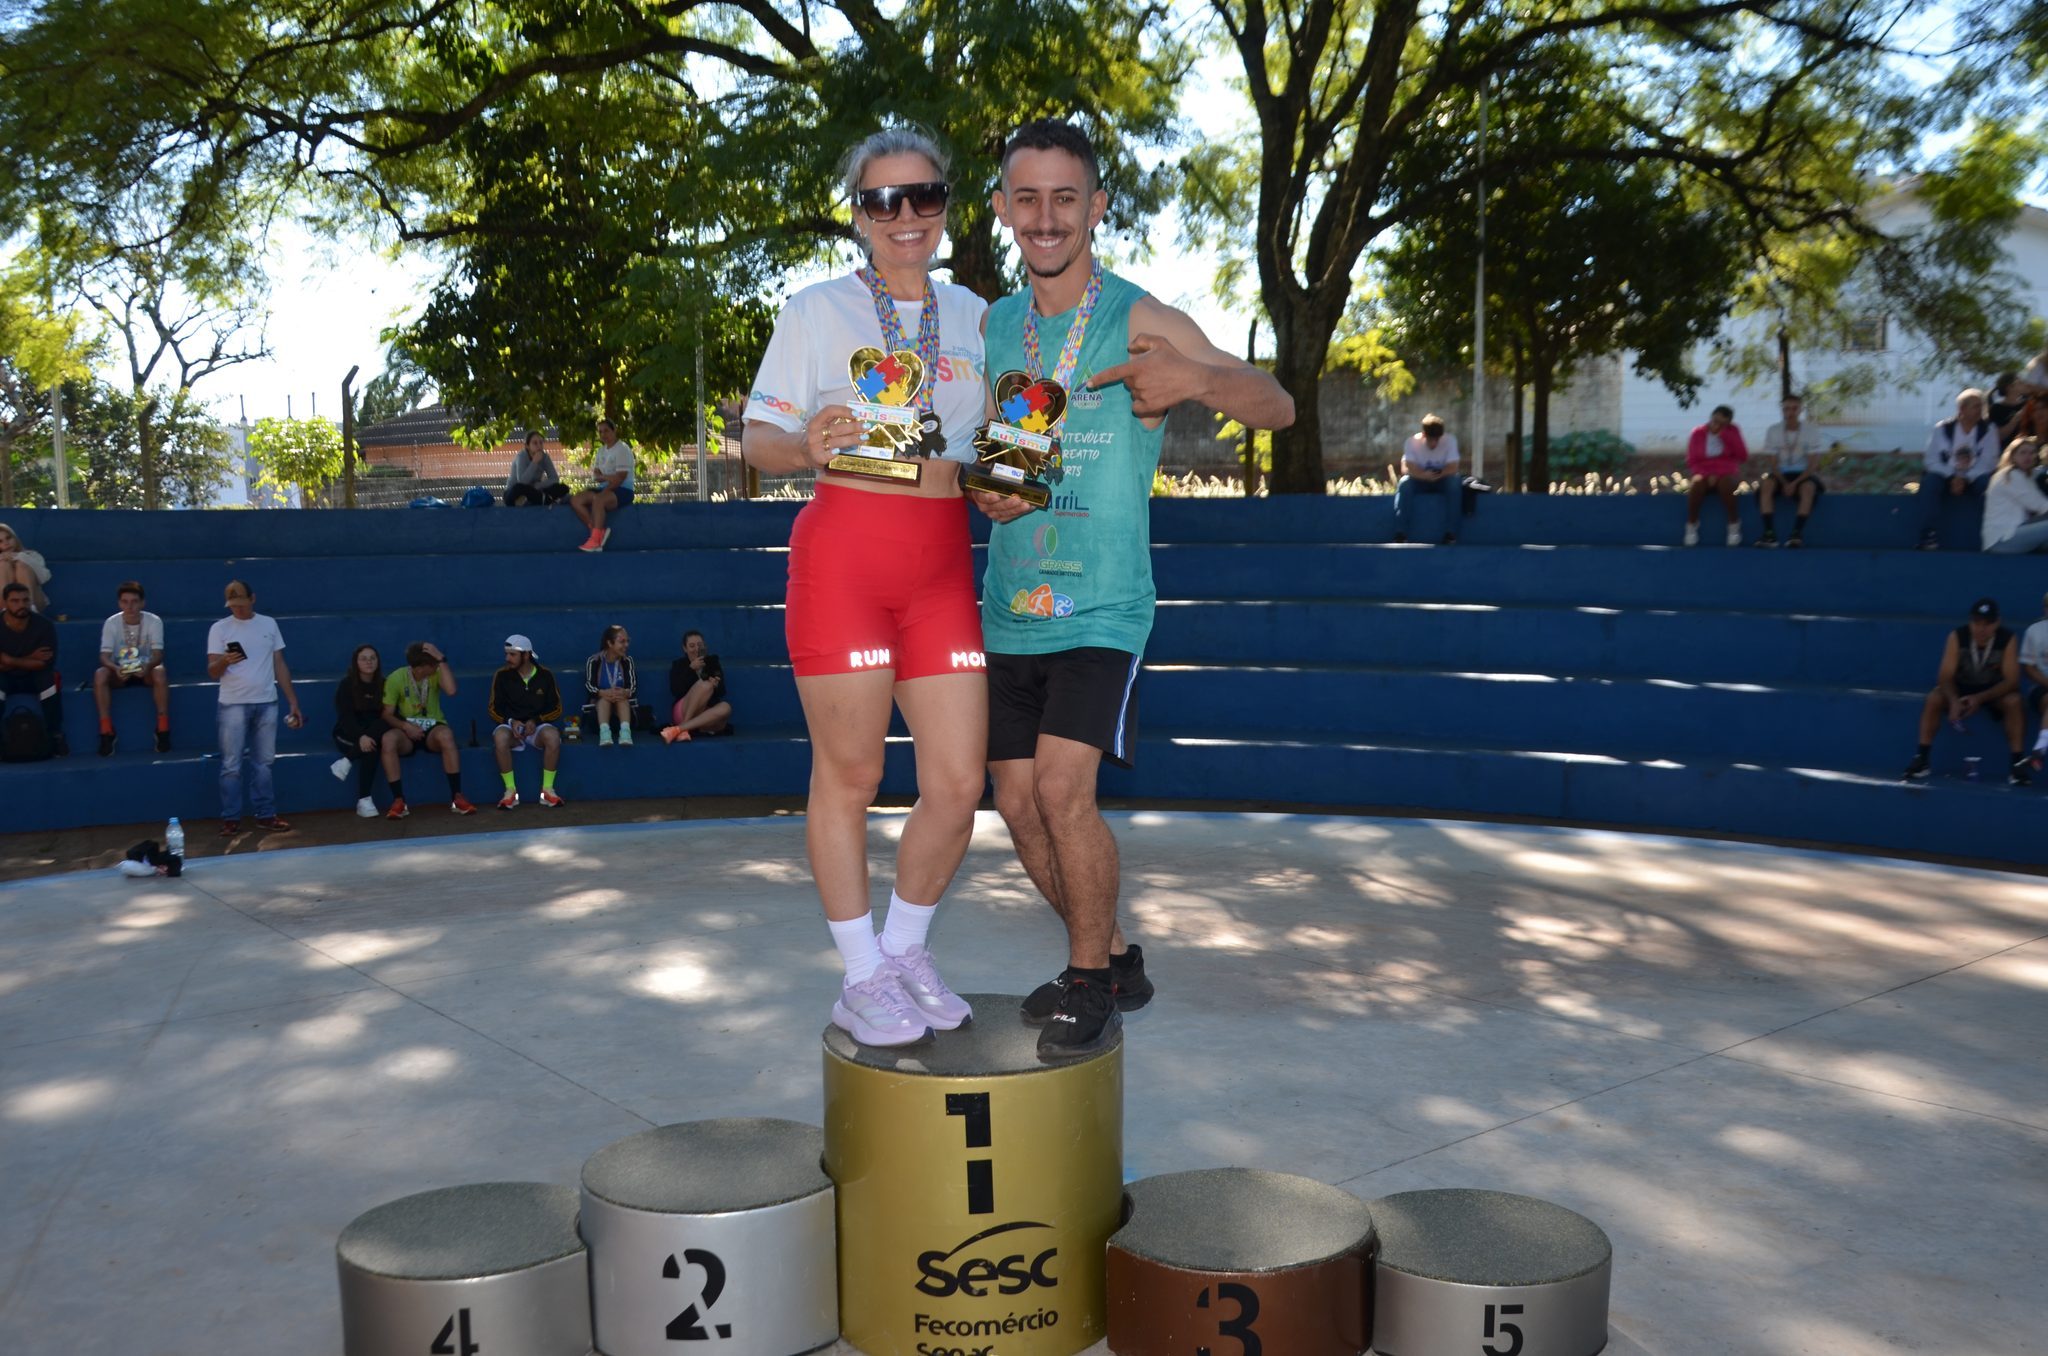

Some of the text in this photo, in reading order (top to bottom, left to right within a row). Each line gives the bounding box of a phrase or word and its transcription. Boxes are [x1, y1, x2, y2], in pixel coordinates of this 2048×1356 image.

[1070, 393, 1103, 401] ARENA
[858, 410, 911, 423] utismo
[991, 430, 1049, 451] Autismo
[1061, 448, 1100, 461] REATTO
[1039, 560, 1082, 572] GRASS
[849, 648, 890, 668] RUN
[1053, 1013, 1076, 1023] FILA
[945, 1092, 994, 1215] 1
[915, 1246, 1058, 1297] Sesc
[662, 1248, 732, 1340] 2
[430, 1307, 480, 1356] 4
[914, 1308, 1059, 1337] Fecomércio
[1196, 1282, 1263, 1356] 3
[1481, 1304, 1524, 1356] 5
